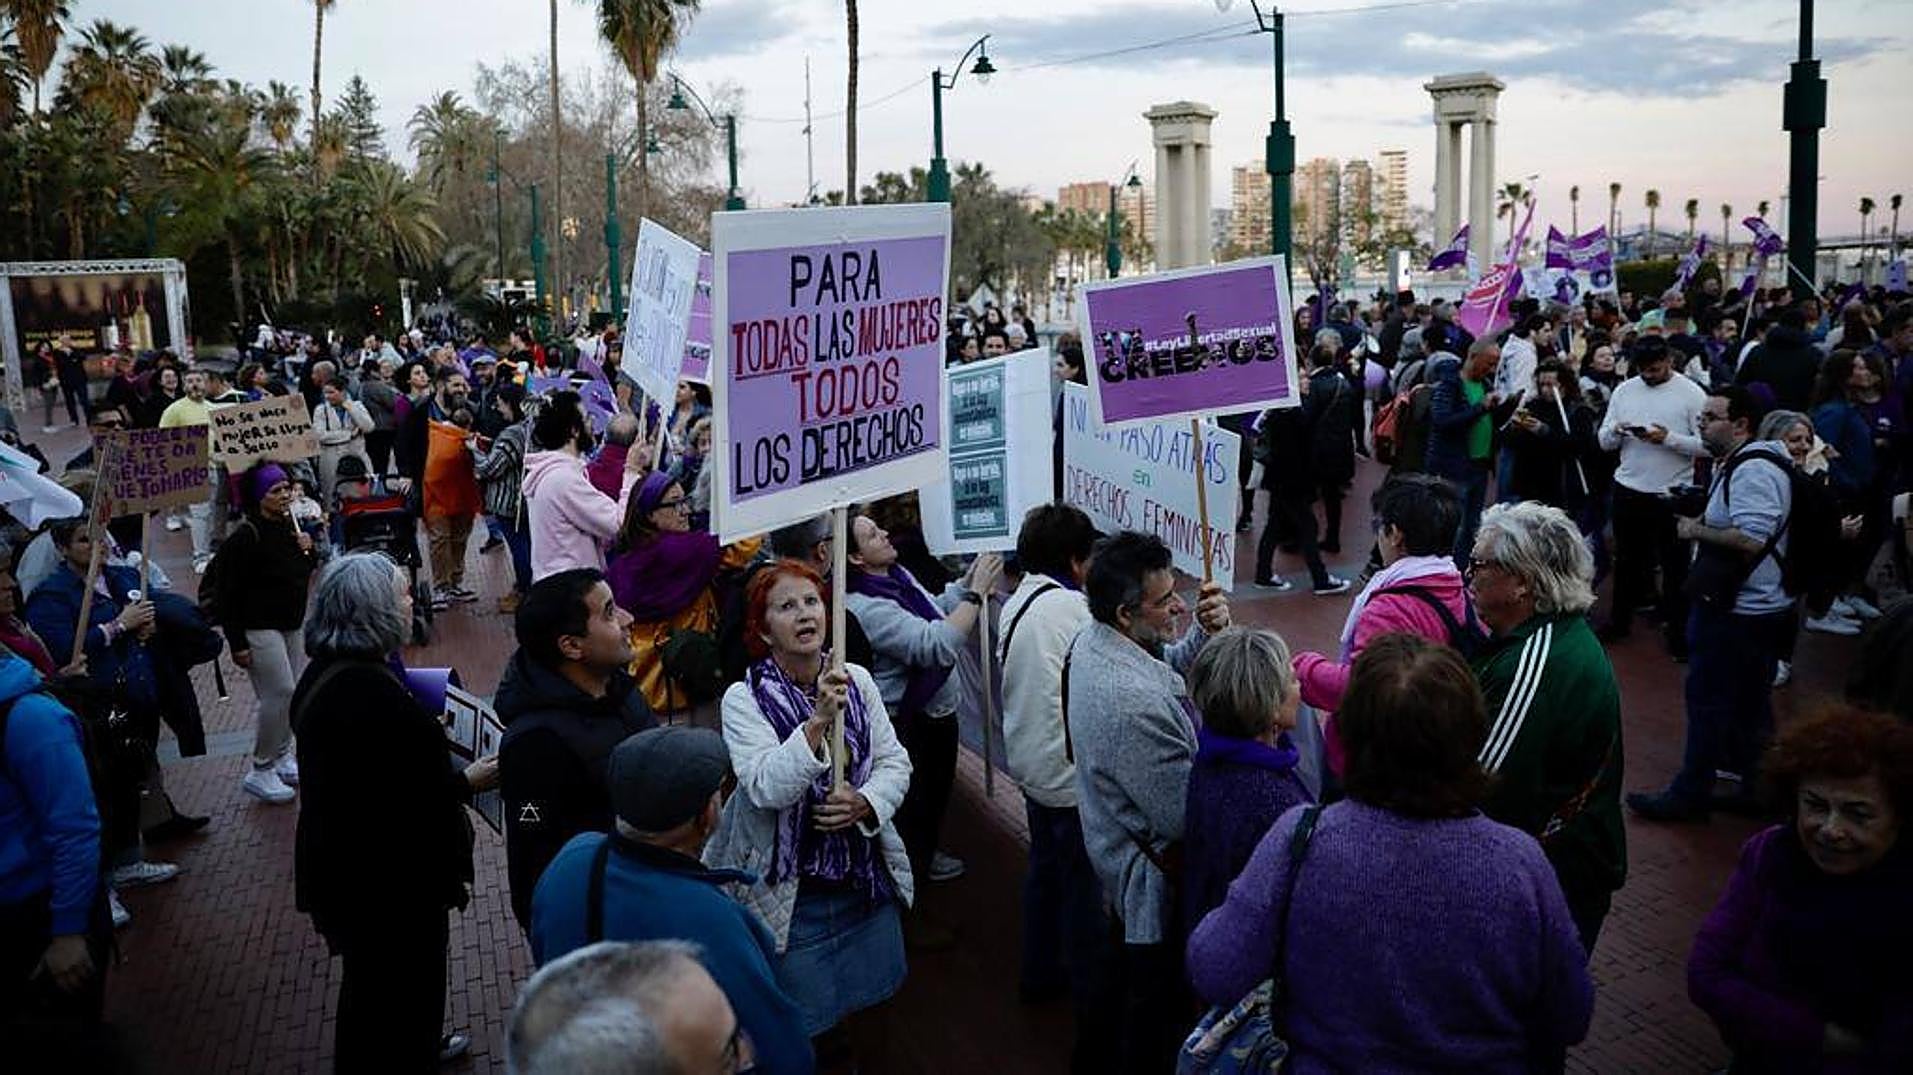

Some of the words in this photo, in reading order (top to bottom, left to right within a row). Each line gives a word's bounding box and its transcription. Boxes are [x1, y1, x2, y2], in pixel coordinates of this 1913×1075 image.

[790, 250, 881, 307] PARA
[733, 315, 808, 375] TODAS
[815, 310, 854, 362] LAS
[858, 297, 941, 356] MUJERES
[1144, 322, 1276, 352] #LeyLiertadSexual
[791, 356, 899, 421] TODOS
[736, 433, 791, 495] LOS
[801, 404, 924, 479] DERECHOS
[1067, 465, 1132, 529] DERECHOS
